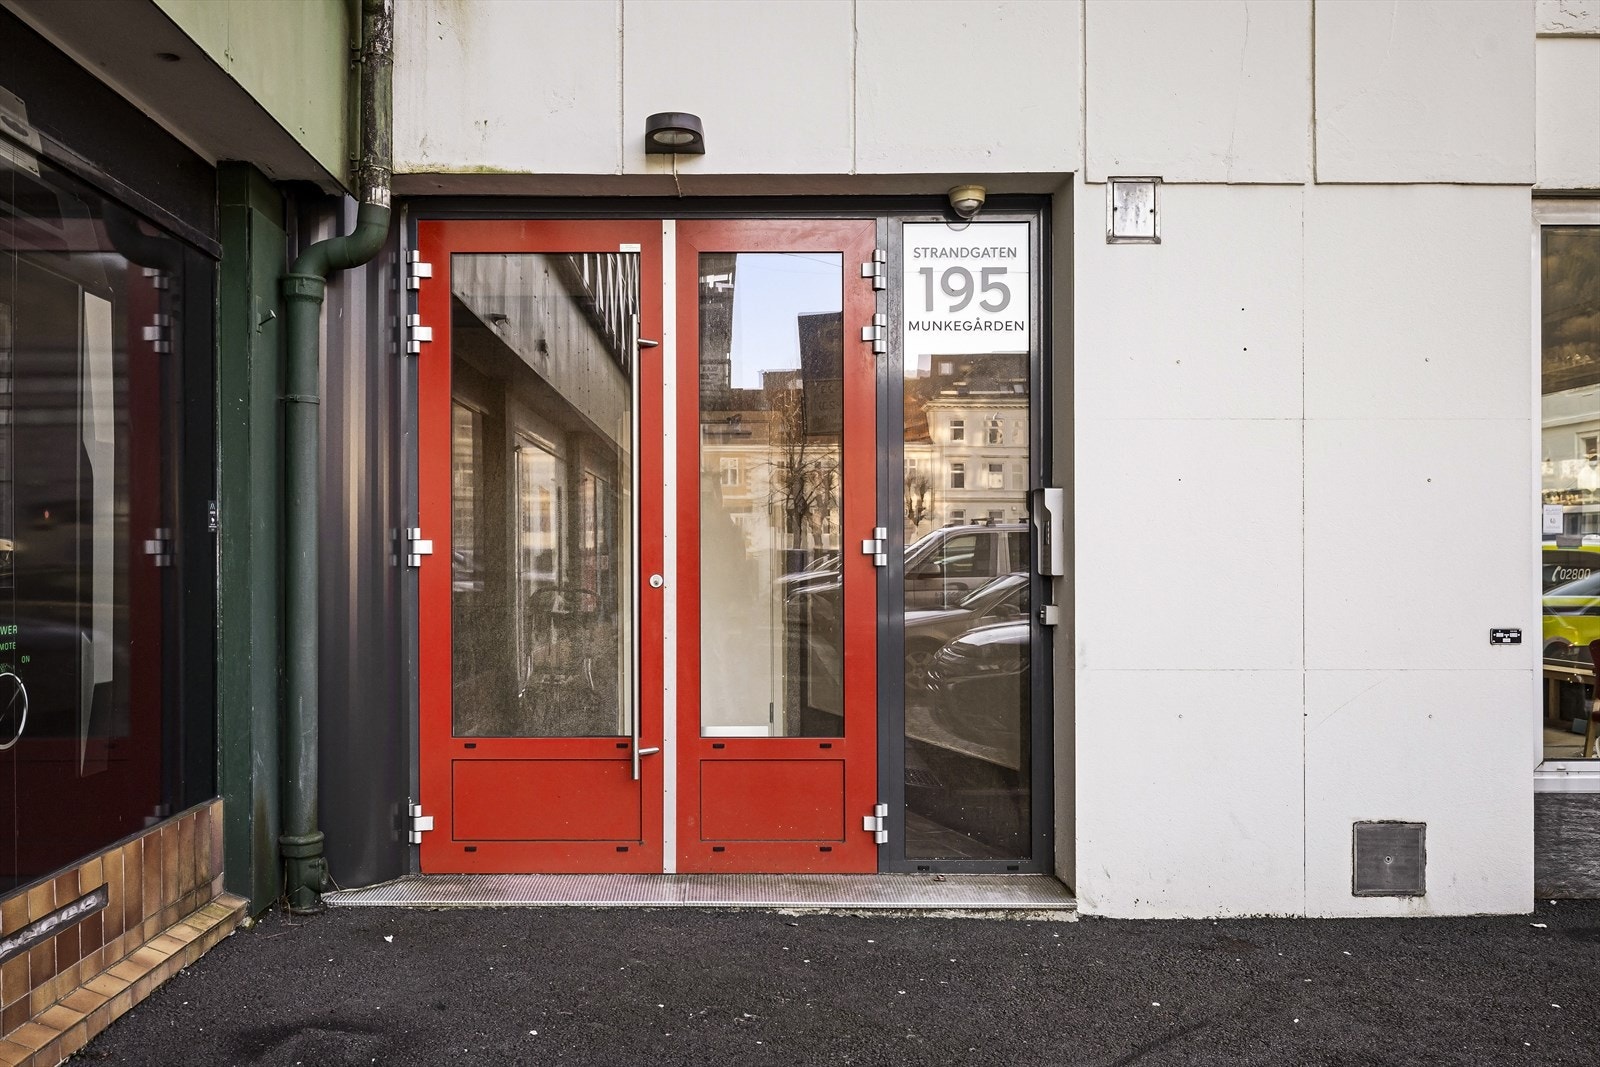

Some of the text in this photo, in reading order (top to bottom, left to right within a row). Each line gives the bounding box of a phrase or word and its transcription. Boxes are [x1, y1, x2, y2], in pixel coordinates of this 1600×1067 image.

[913, 247, 1017, 258] STRANDGATEN
[919, 266, 1011, 313] 195
[908, 317, 1025, 331] MUNKEGÅRDEN
[1560, 568, 1590, 580] 02800
